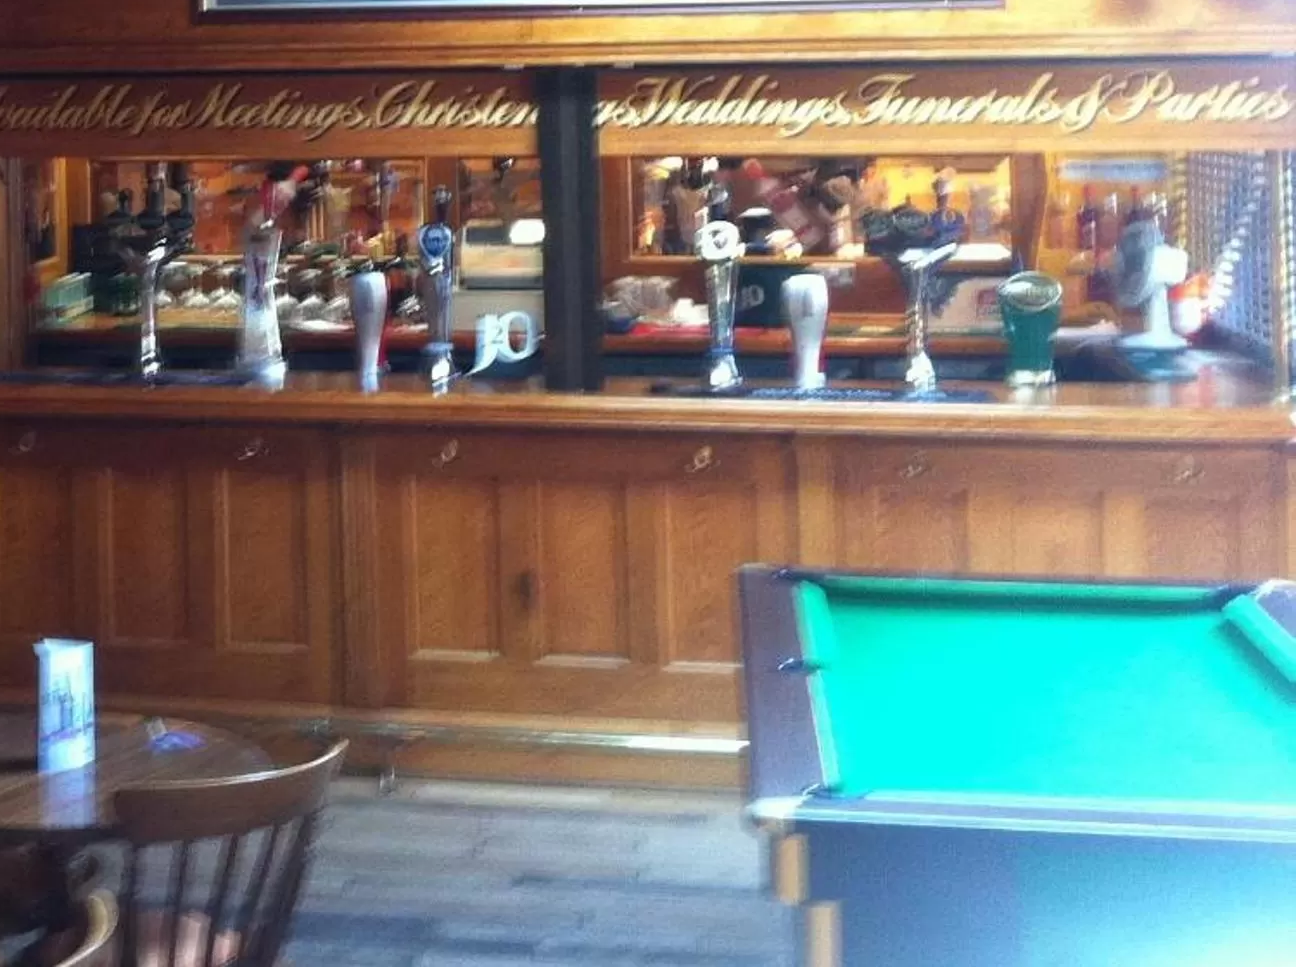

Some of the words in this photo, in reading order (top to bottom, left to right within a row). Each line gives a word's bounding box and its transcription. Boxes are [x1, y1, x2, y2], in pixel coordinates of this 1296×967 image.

[130, 92, 189, 135] for
[855, 72, 1062, 126] Funerals
[1061, 74, 1116, 133] &
[1107, 68, 1292, 124] Parties
